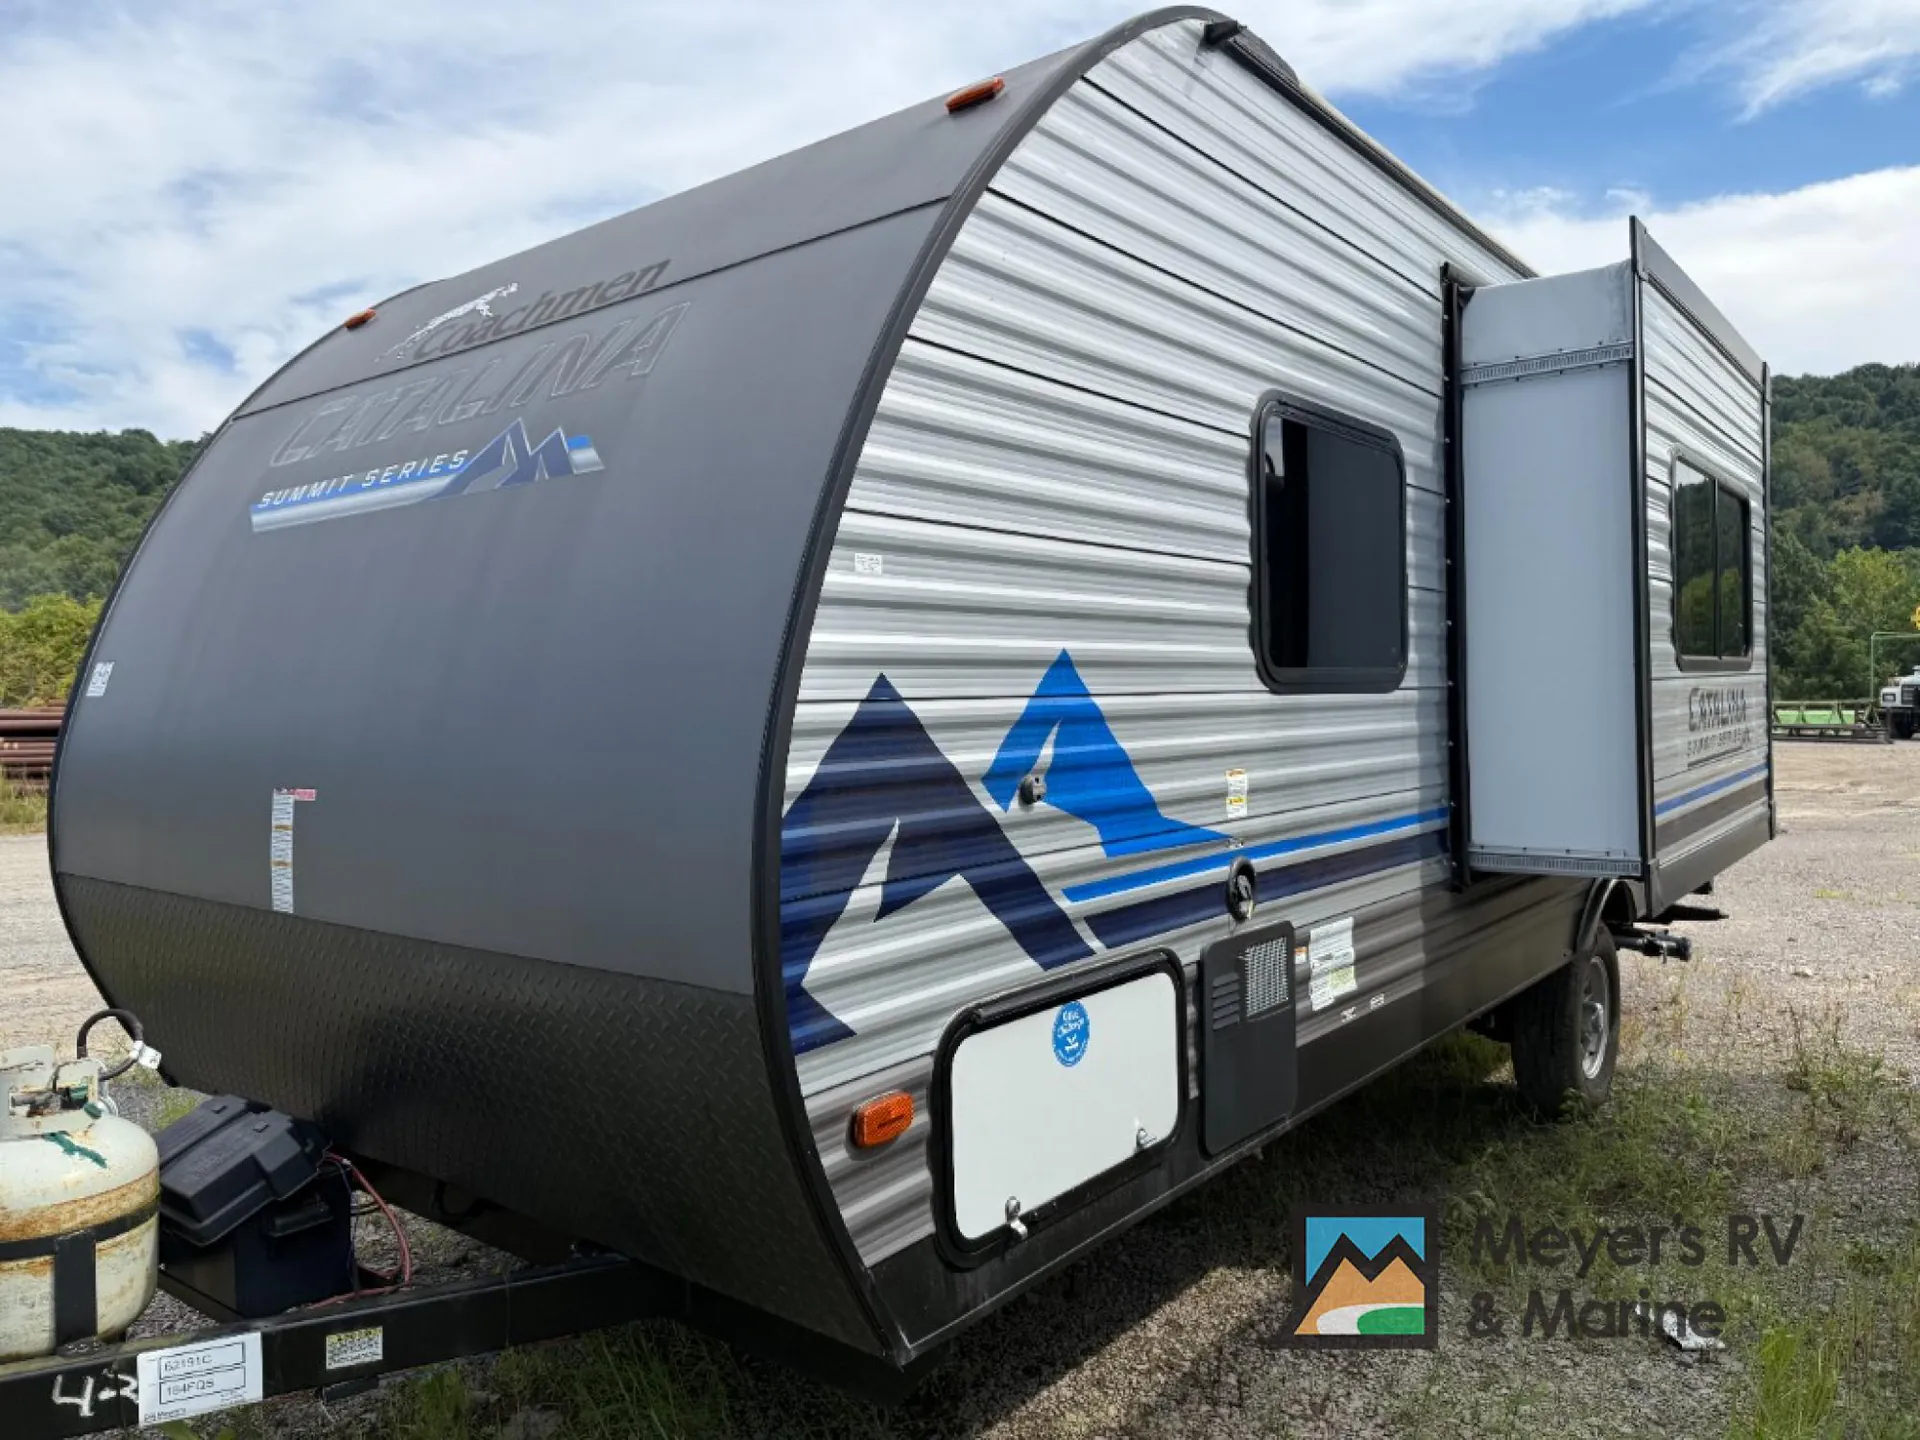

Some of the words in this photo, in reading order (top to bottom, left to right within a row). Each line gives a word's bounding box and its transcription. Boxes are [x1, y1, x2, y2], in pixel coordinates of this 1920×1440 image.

[412, 258, 671, 361] Coachmen
[270, 301, 692, 468] CATALINA
[257, 473, 354, 509] SUMMIT
[361, 449, 469, 488] SERIES
